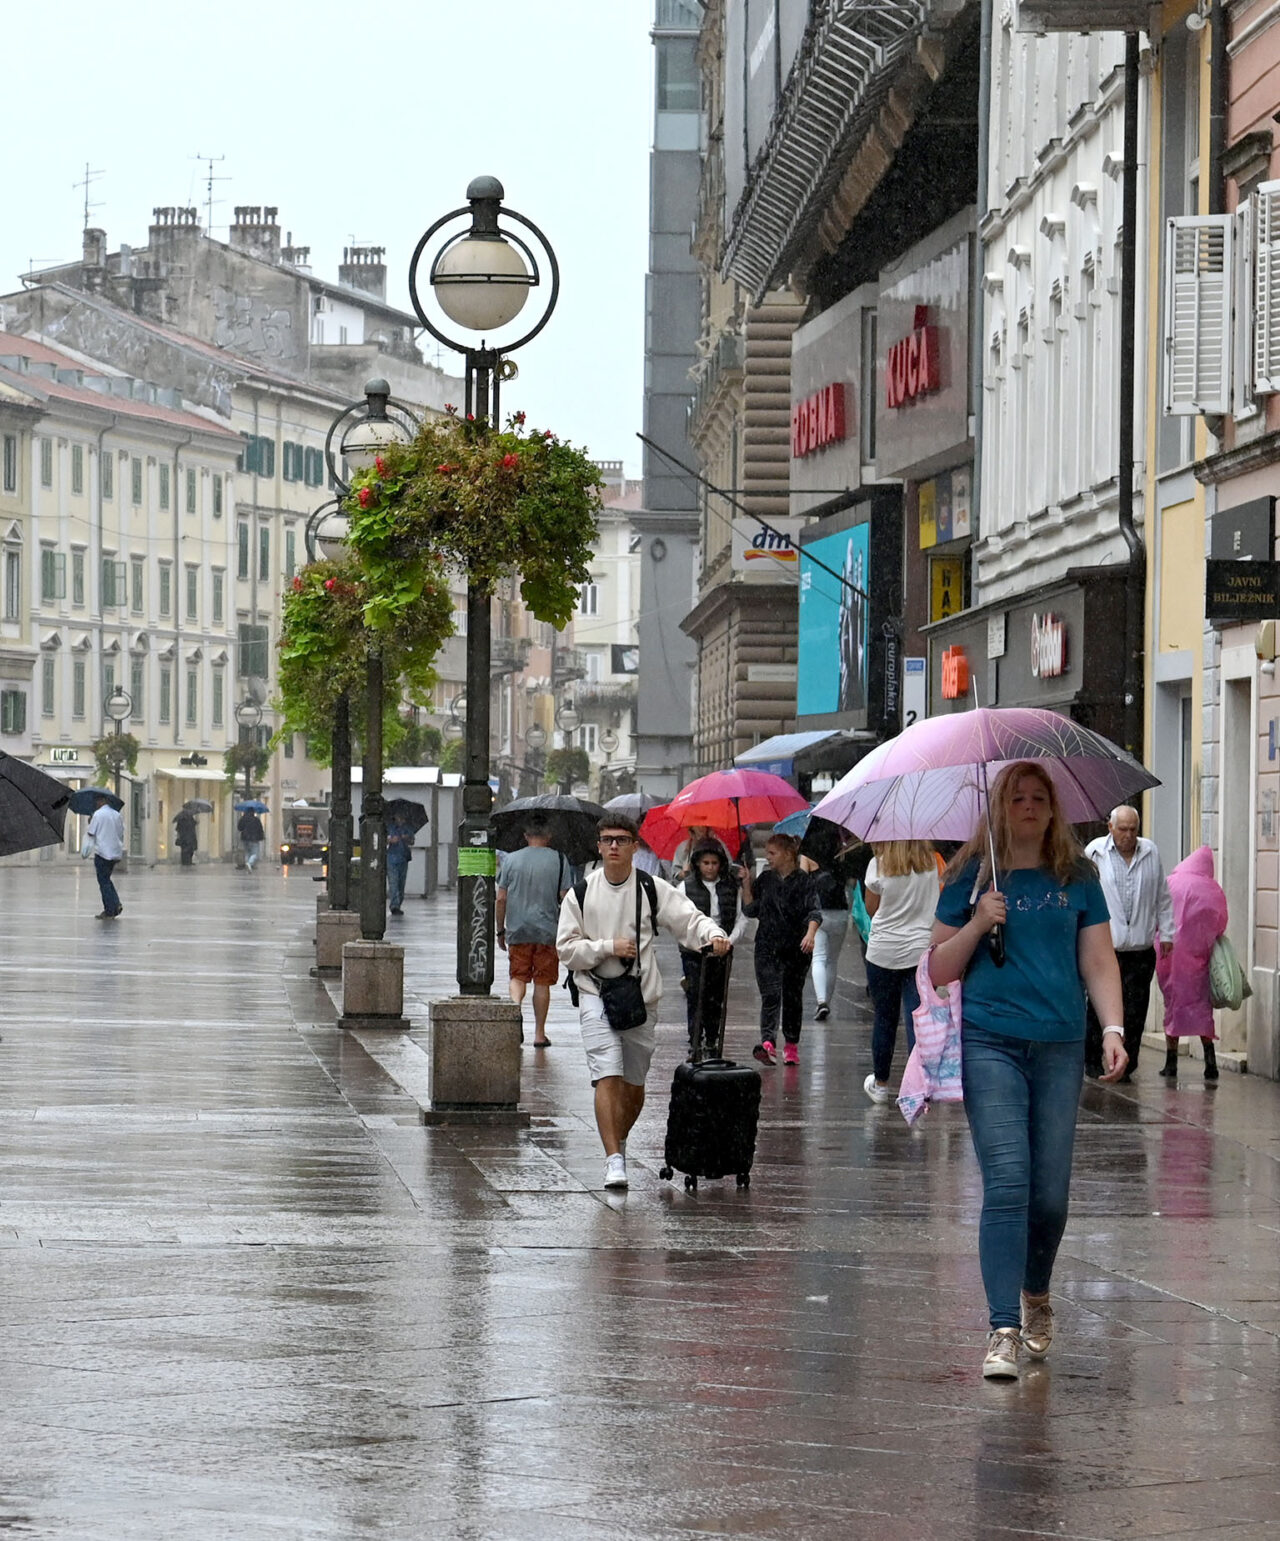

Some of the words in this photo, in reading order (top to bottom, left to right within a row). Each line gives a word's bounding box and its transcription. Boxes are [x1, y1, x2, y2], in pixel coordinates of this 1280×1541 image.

[793, 383, 845, 459] ROBNA
[752, 525, 791, 550] dm
[1227, 576, 1262, 587] JAVNI
[887, 642, 899, 712] europlakat
[906, 709, 918, 728] 2
